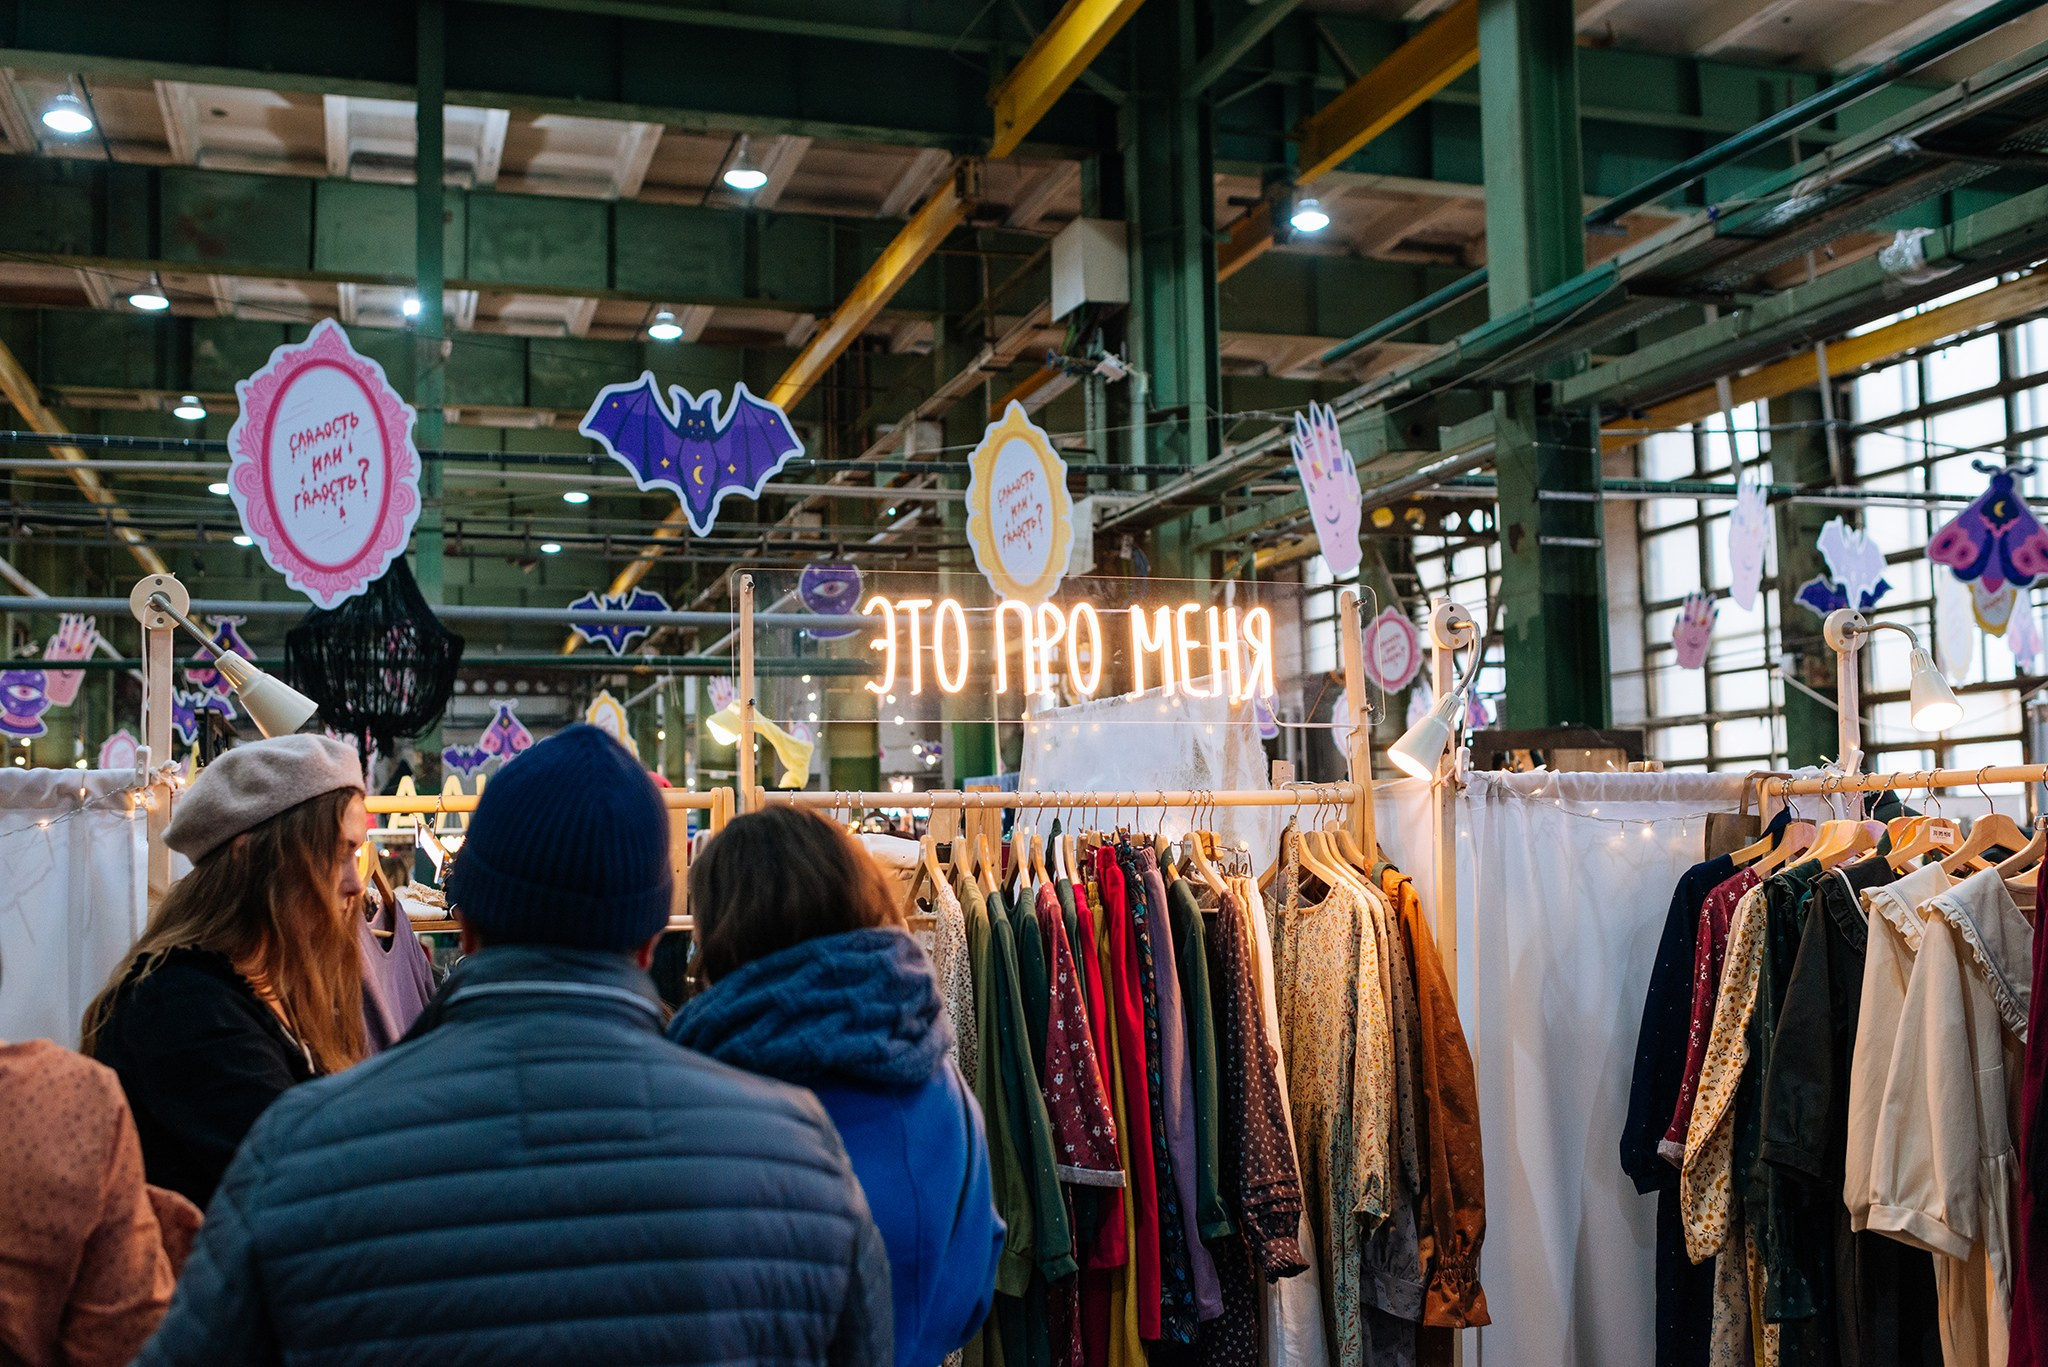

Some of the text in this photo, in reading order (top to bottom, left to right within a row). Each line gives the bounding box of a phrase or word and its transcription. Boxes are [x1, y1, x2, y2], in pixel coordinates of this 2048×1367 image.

[289, 411, 359, 456] СЛАДОСТЬ
[312, 445, 342, 476] ИЛИ
[863, 595, 1273, 700] ЭТО ПРО МЕНЯ
